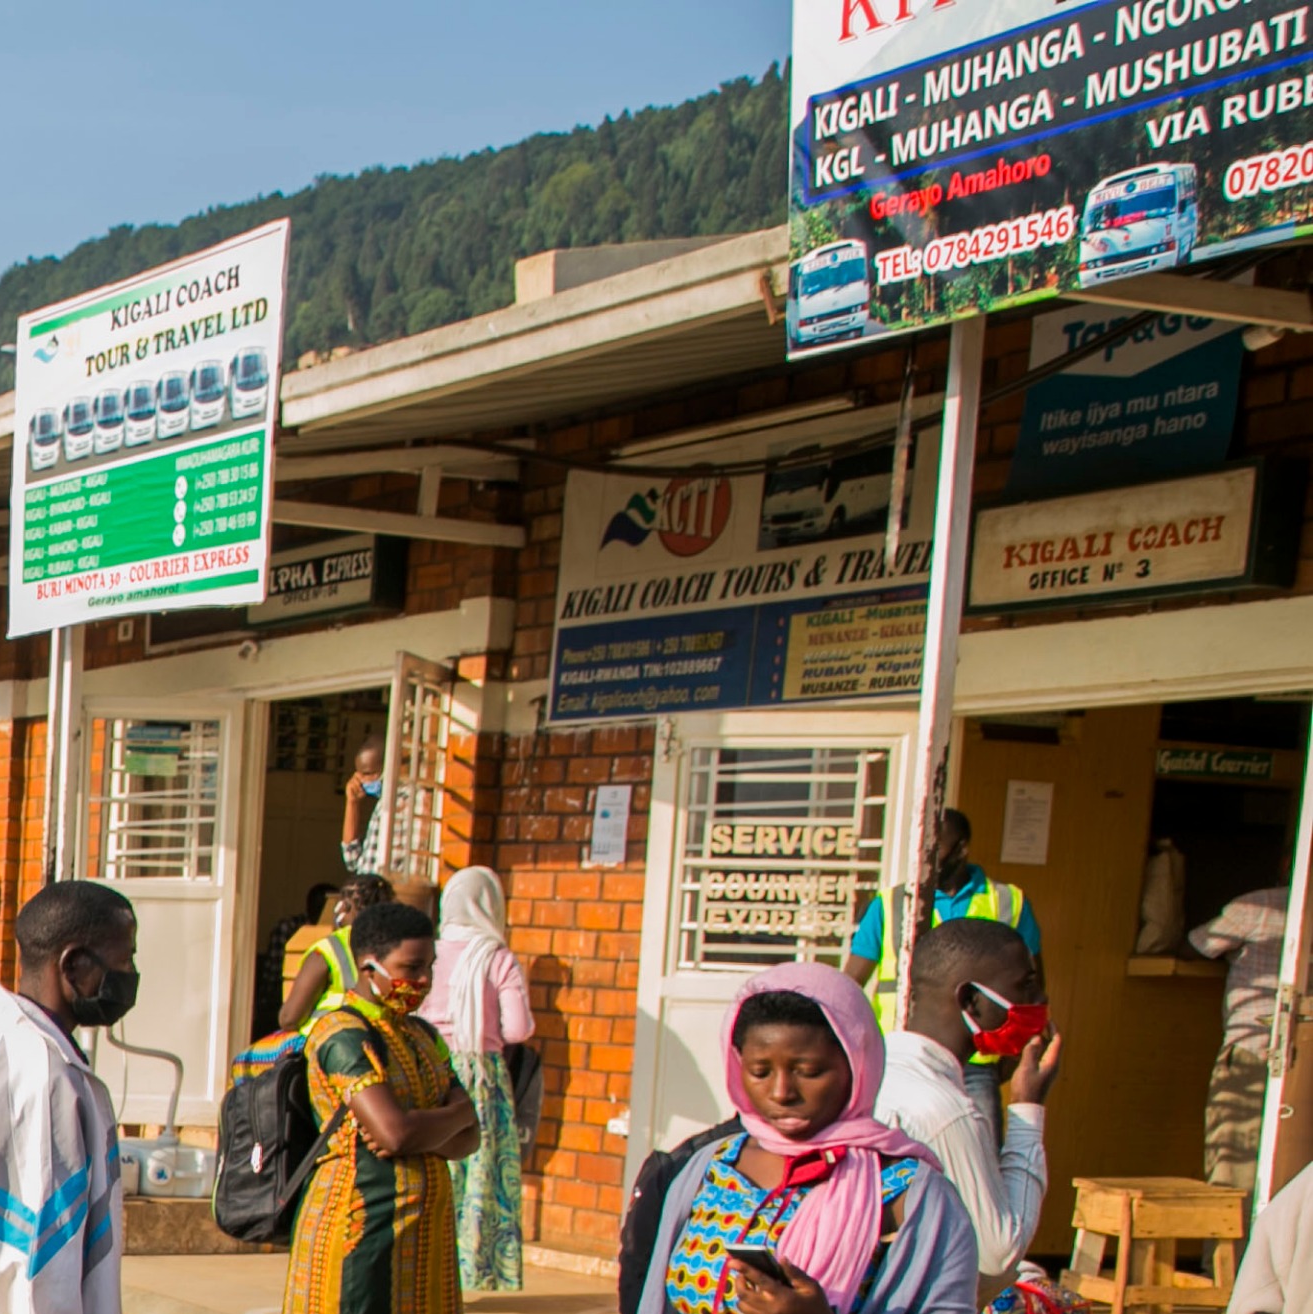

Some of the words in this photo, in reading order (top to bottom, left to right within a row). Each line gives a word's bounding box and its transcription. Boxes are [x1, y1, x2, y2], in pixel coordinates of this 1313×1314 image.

[814, 81, 900, 141] KIGALI
[923, 22, 1085, 107] MUHANGA
[815, 146, 866, 188] KGL
[891, 89, 1055, 166] MUHANGA
[1085, 6, 1309, 110] MUSHUBATI
[1145, 105, 1211, 149] VIA
[870, 182, 942, 220] Gerayo
[947, 154, 1052, 199] Amahoro
[878, 250, 919, 280] TEL:
[926, 211, 1070, 269] 0784291546
[111, 290, 172, 331] KIGALI
[176, 264, 241, 308] COACH
[85, 343, 131, 378] TOUR
[135, 337, 149, 360] &
[152, 312, 226, 356] TRAVEL
[230, 297, 269, 332] LTD
[1040, 411, 1081, 433] Itike
[1086, 402, 1121, 426] ijya
[1126, 394, 1158, 415] mu
[1164, 381, 1220, 407] ntara
[1042, 422, 1148, 457] wayisanga
[1154, 411, 1207, 436] hano
[1003, 531, 1115, 569] KIGALI
[1127, 515, 1226, 552] COACH
[36, 580, 62, 600] BURI
[65, 573, 105, 594] MINOTA
[108, 573, 121, 591] 30
[129, 557, 191, 583] COURRIER
[194, 545, 250, 572] EXPRESS
[269, 561, 317, 593] LPHA
[560, 578, 639, 620] KIGALI
[640, 569, 711, 611] COACH
[723, 559, 797, 597] TOURS
[803, 555, 828, 586] &
[1029, 566, 1090, 590] OFFICE
[1135, 559, 1151, 578] 3
[87, 593, 124, 607] Gerayo
[806, 610, 855, 627] KIGALI
[800, 679, 859, 695] MUSANZE
[869, 674, 920, 690] RUBAVU
[802, 663, 866, 679] RUBAVU
[710, 825, 859, 856] SERVICE
